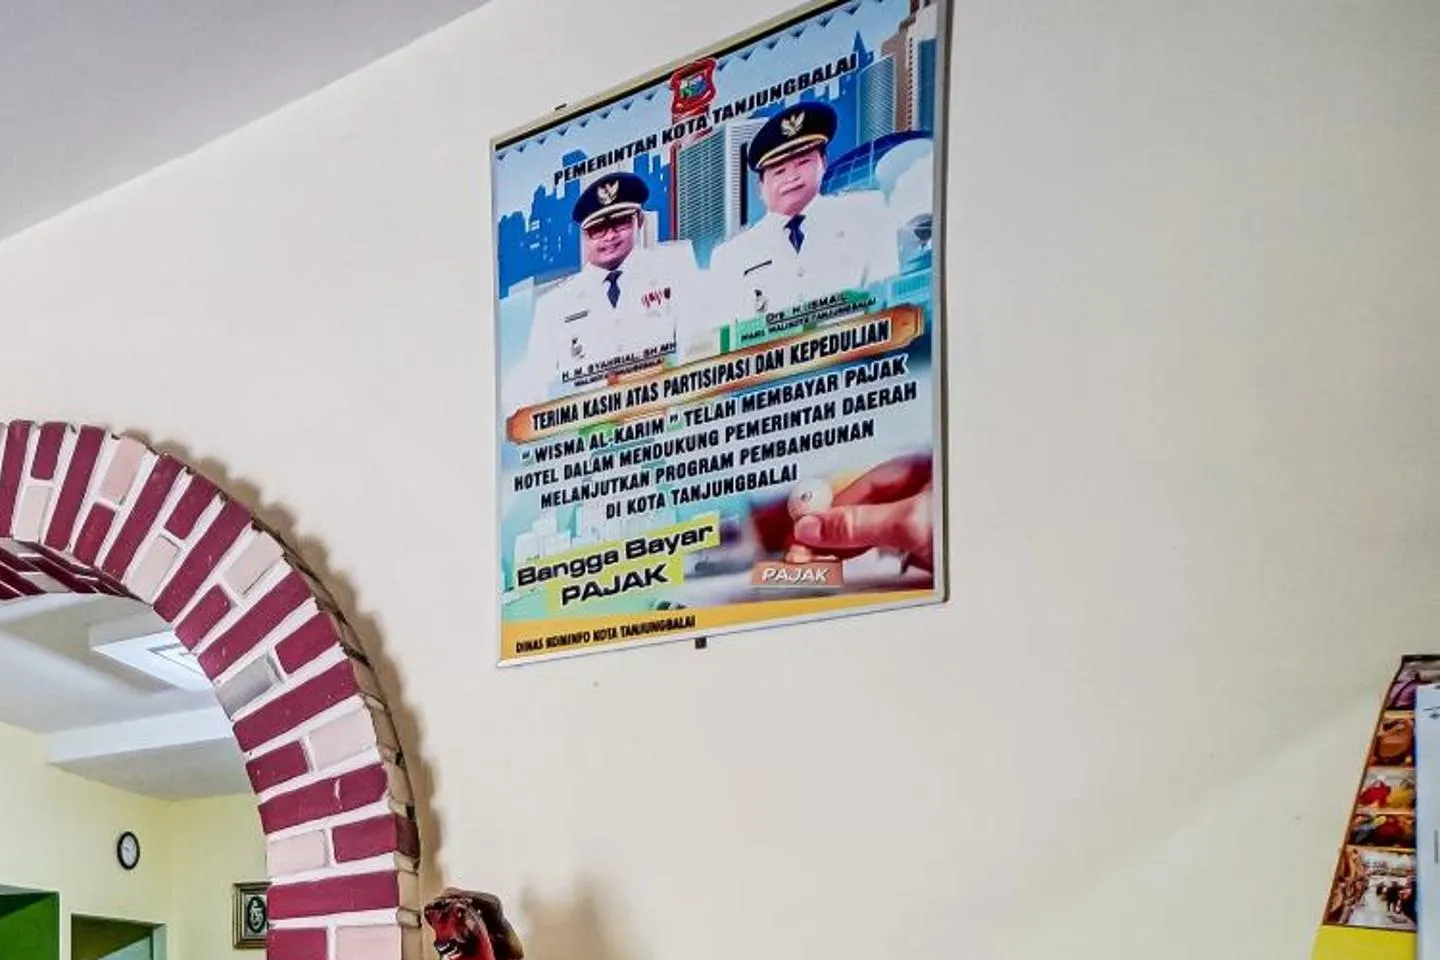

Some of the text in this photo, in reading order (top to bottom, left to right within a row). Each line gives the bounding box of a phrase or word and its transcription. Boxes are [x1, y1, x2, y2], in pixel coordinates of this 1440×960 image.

[554, 53, 857, 184] PEMERINTAH KOTA TANJUNGBALAI
[533, 320, 889, 430] TERIMA KASIH ATAS PARTISIPASI DAN KEPEDULIAN
[535, 437, 585, 463] WISMA
[590, 417, 664, 451] AL-KARIM
[684, 400, 735, 427] TELAH
[742, 374, 838, 413] MEMBAYAR
[845, 356, 906, 388] PAJAK
[514, 381, 917, 491] HOTEL DALAM MENDUKUNG PEMERINTAH DAERAH
[541, 418, 875, 509] MELANJUTKAN PROGRAM PEMBANGUNAN
[606, 464, 797, 519] DI KOTA TANJUNGBALAI
[517, 525, 714, 587] Bangga Bayar
[562, 563, 668, 606] PAJAK
[762, 567, 829, 583] PAJAK
[516, 637, 543, 653] DINAS
[593, 626, 619, 642] KOTA
[621, 615, 696, 637] TANJUNGBALAI
